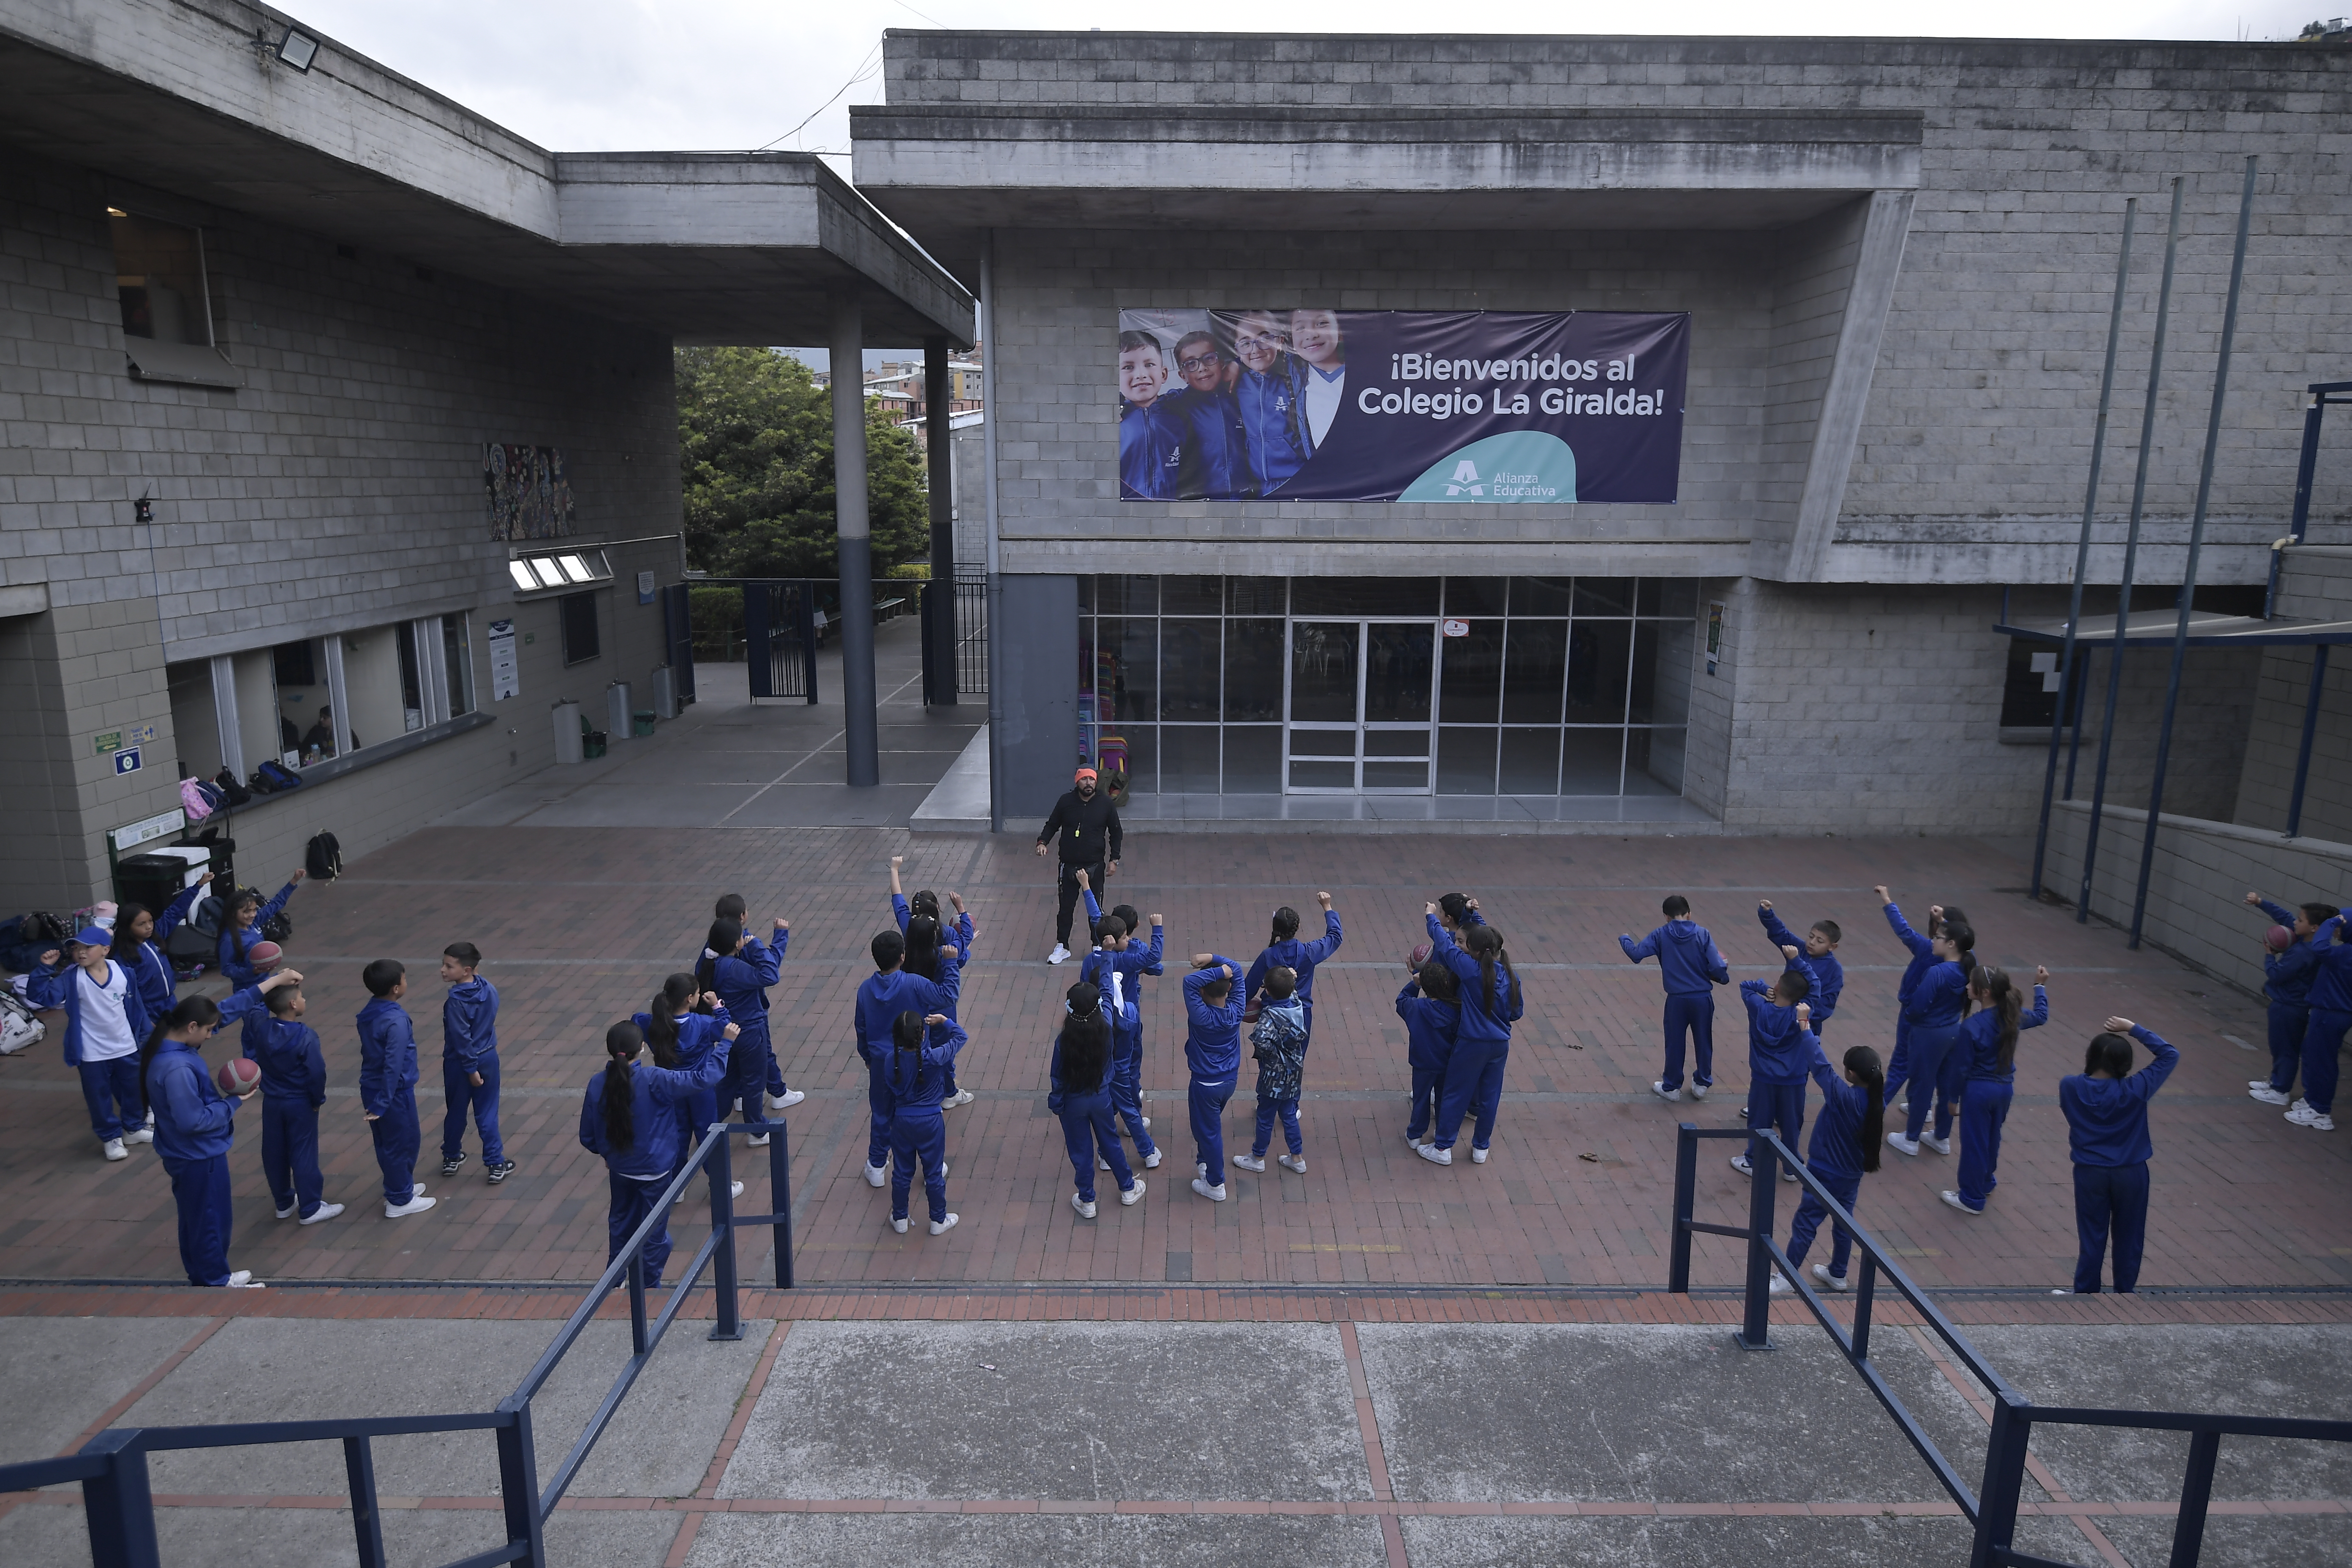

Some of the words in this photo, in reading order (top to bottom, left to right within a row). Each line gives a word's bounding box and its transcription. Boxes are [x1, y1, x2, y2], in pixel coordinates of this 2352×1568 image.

[1391, 352, 1598, 381] ¡Bienvenidos
[1606, 353, 1635, 381] al
[1358, 386, 1483, 420] Colegio
[1493, 388, 1530, 414] La
[1540, 387, 1664, 416] Giralda!
[1494, 472, 1538, 484] Alianza
[1494, 485, 1556, 496] Educativa
